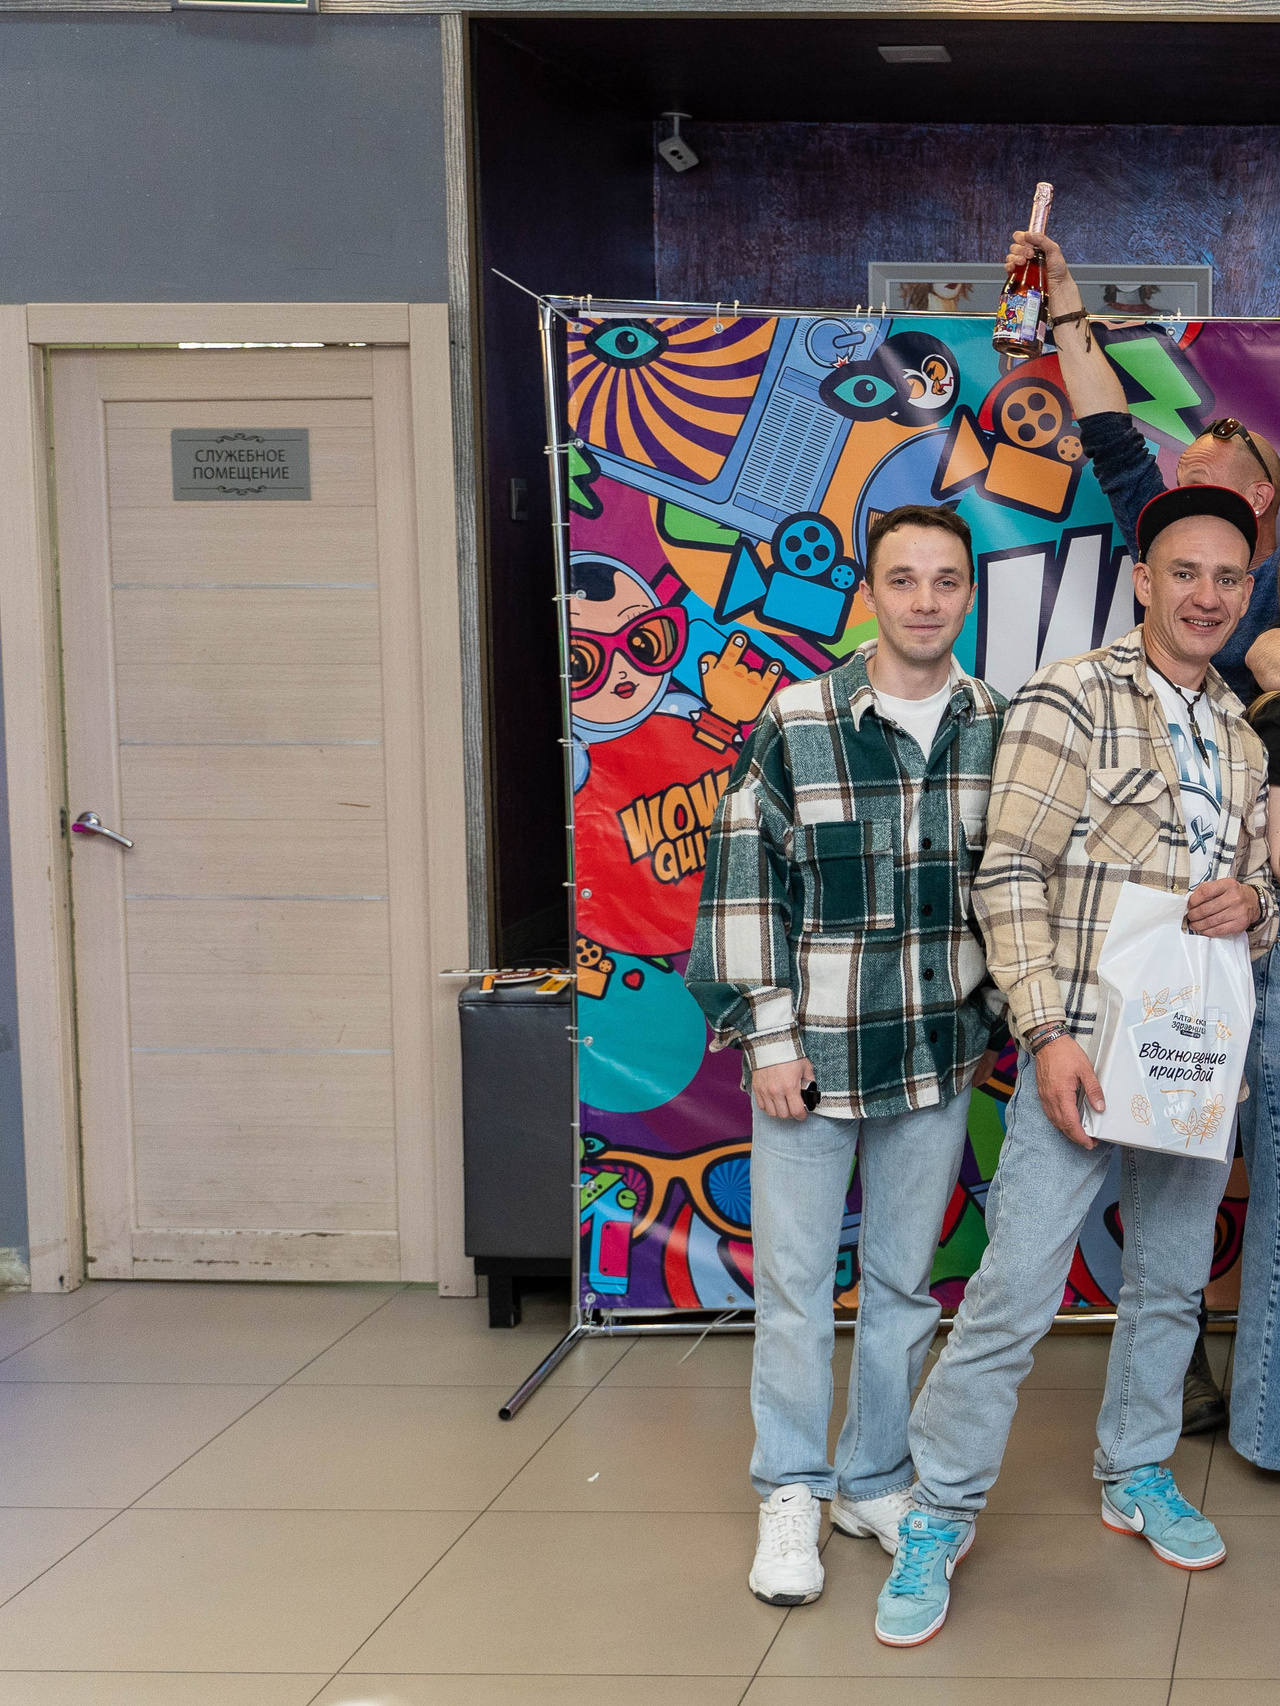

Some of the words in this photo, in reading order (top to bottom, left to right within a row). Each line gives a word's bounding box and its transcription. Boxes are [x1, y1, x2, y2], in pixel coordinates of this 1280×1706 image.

[195, 449, 287, 463] СЛУЖЕБНОЕ
[193, 466, 290, 481] ПОМЕЩЕНИЕ
[653, 828, 711, 884] QUI
[1139, 1041, 1227, 1066] Вдохновение
[1149, 1063, 1214, 1083] природой
